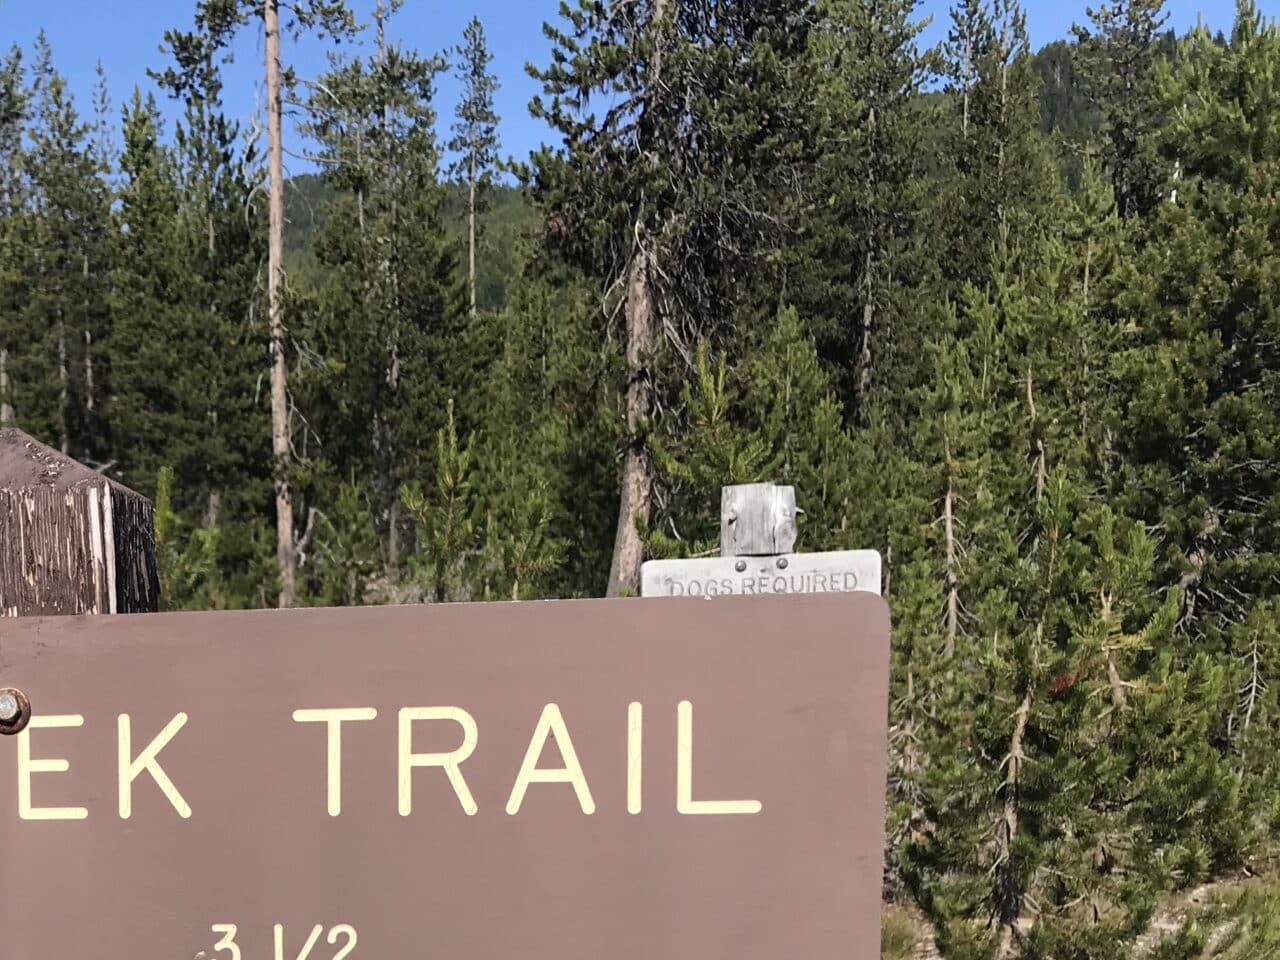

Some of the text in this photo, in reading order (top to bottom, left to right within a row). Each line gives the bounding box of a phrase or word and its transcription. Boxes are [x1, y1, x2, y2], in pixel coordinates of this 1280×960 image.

[669, 571, 858, 596] DOGS REQUIRED
[292, 700, 762, 817] TRAIL
